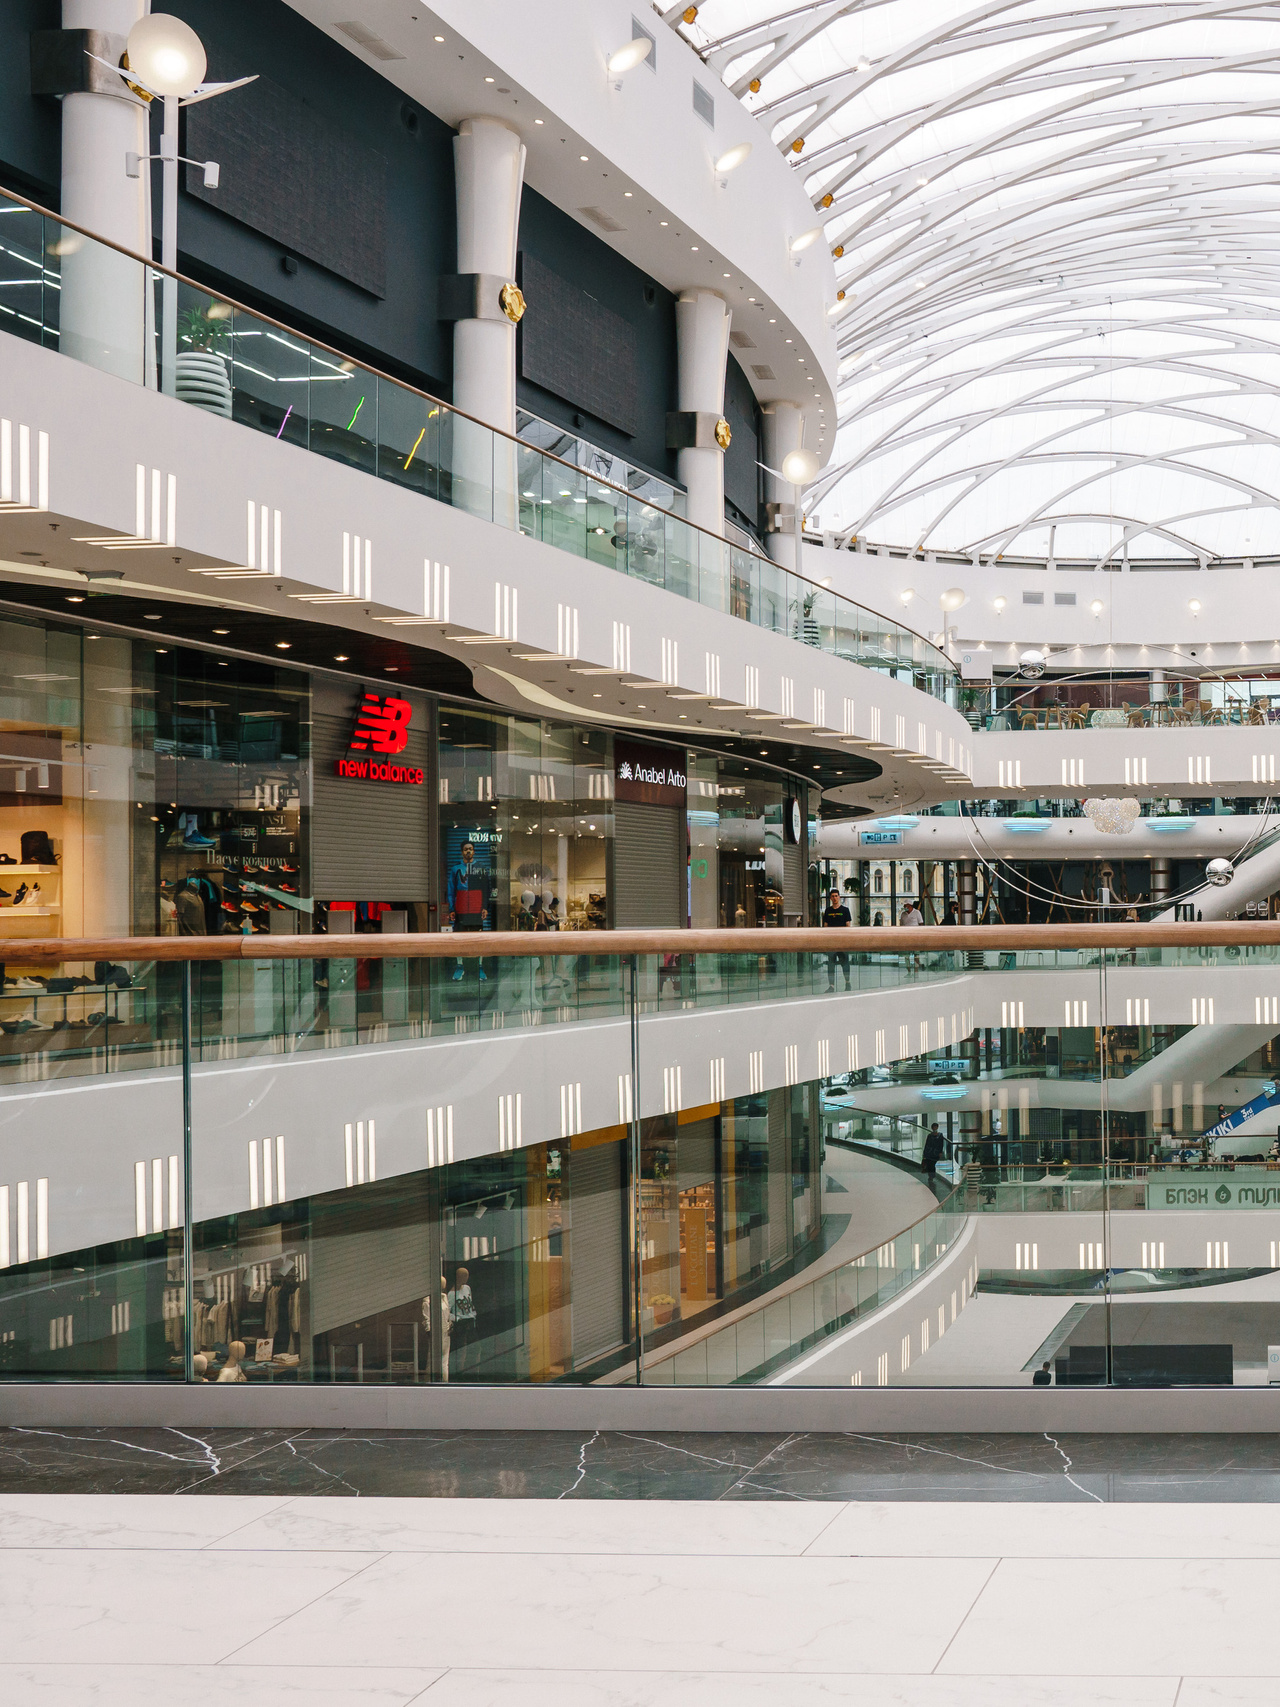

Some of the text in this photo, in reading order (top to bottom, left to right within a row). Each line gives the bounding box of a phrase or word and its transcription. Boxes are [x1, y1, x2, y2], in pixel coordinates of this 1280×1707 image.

[337, 758, 424, 785] new balance
[634, 763, 687, 788] Anabel Arto
[1165, 1188, 1209, 1205] БЛЭК
